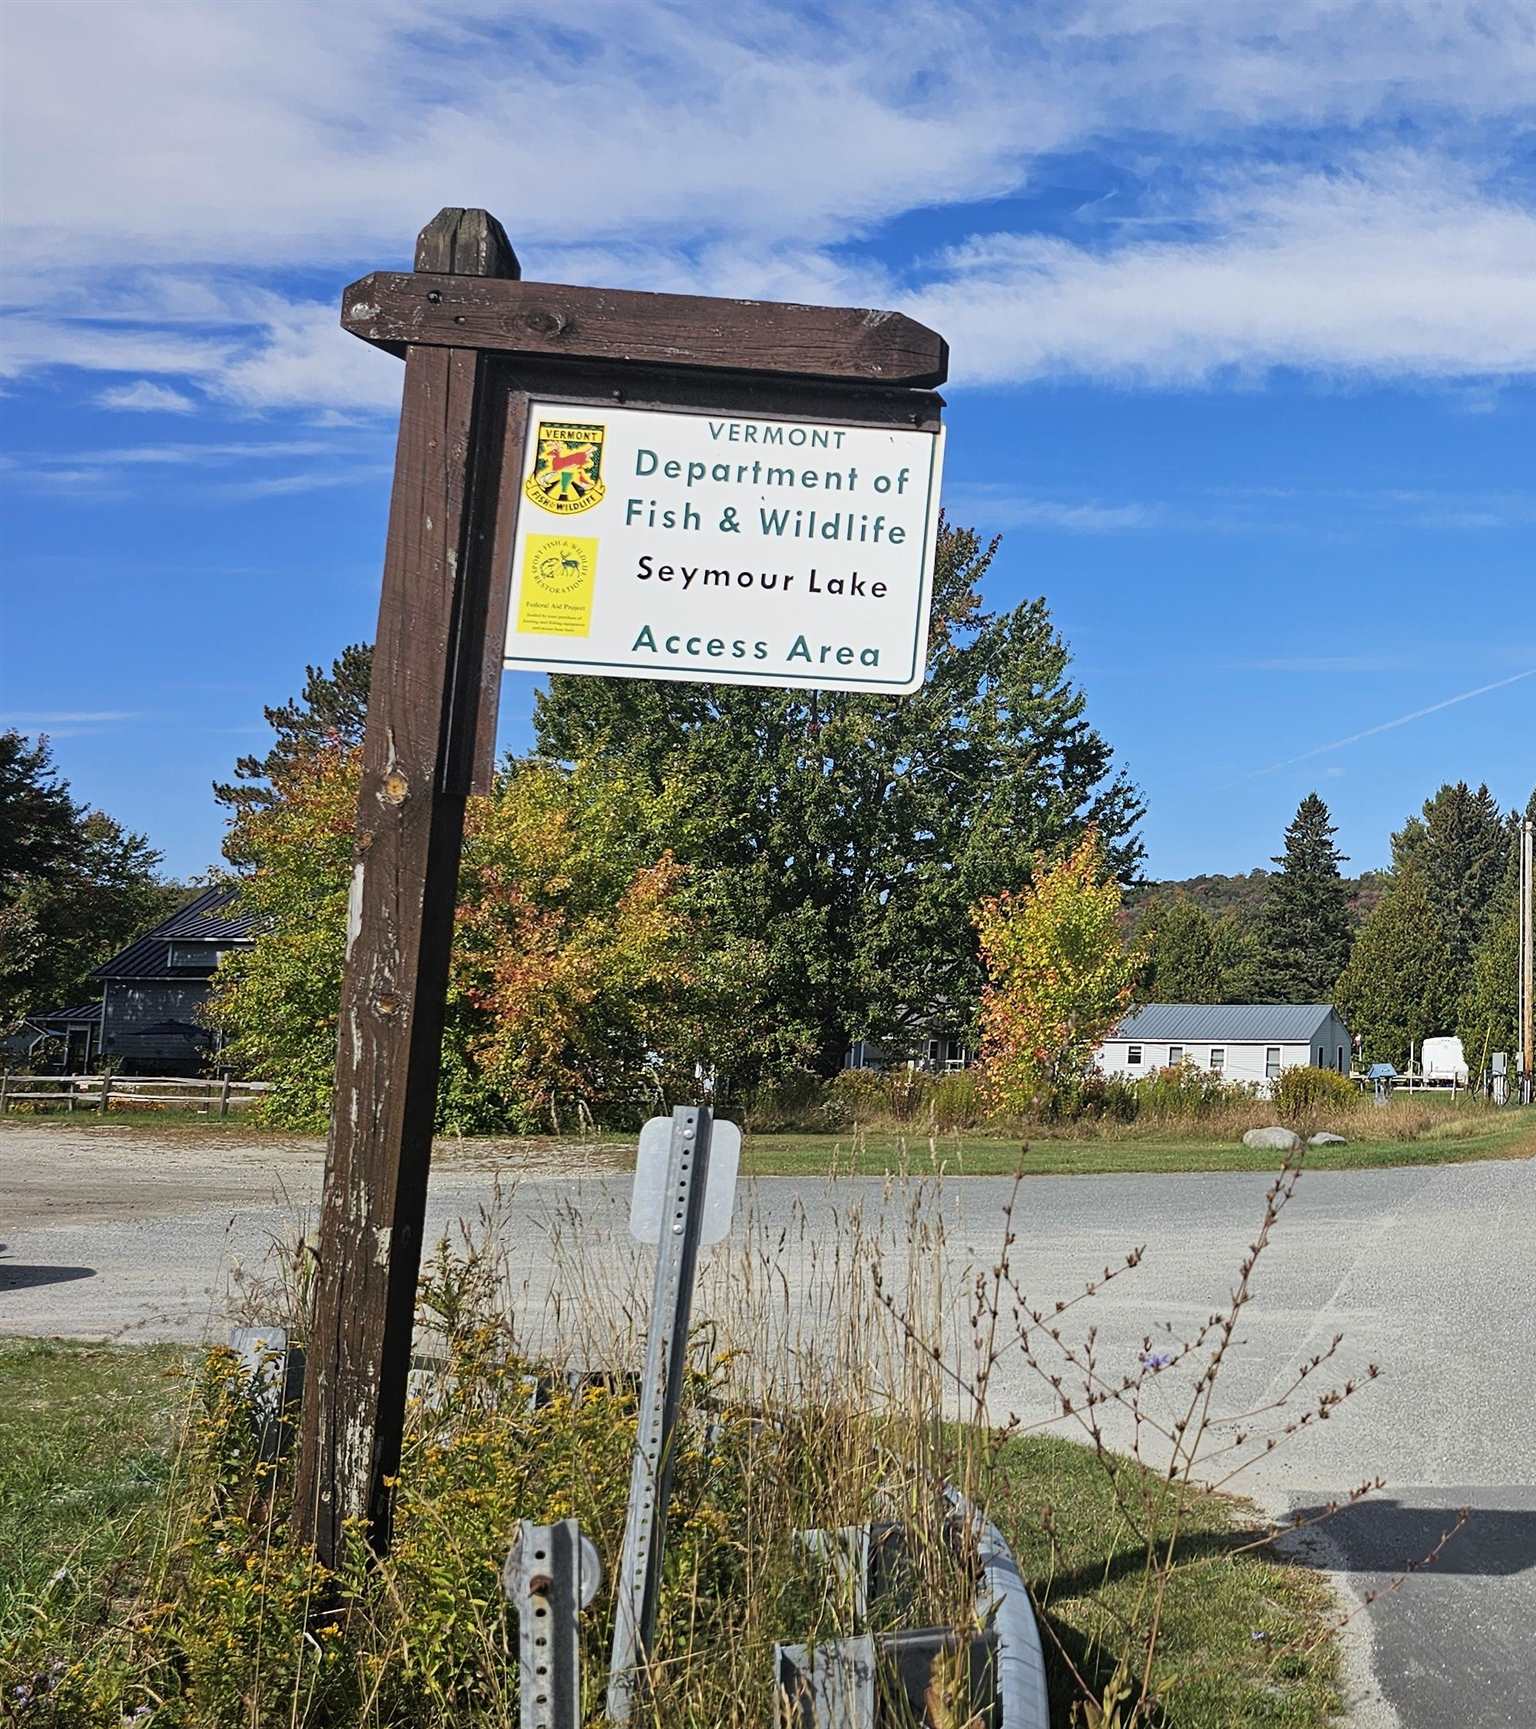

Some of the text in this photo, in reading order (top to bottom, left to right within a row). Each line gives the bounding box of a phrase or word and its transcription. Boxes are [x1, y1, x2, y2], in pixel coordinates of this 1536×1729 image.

[546, 430, 597, 441] VERMONT
[708, 422, 846, 449] VERMONT
[635, 448, 910, 495] Department of
[531, 491, 548, 506] FISH
[556, 496, 597, 511] WILDLIFE
[625, 499, 907, 545] Fish & Wildlife
[637, 555, 889, 599] Seymour Lake
[632, 625, 881, 667] Access Area
